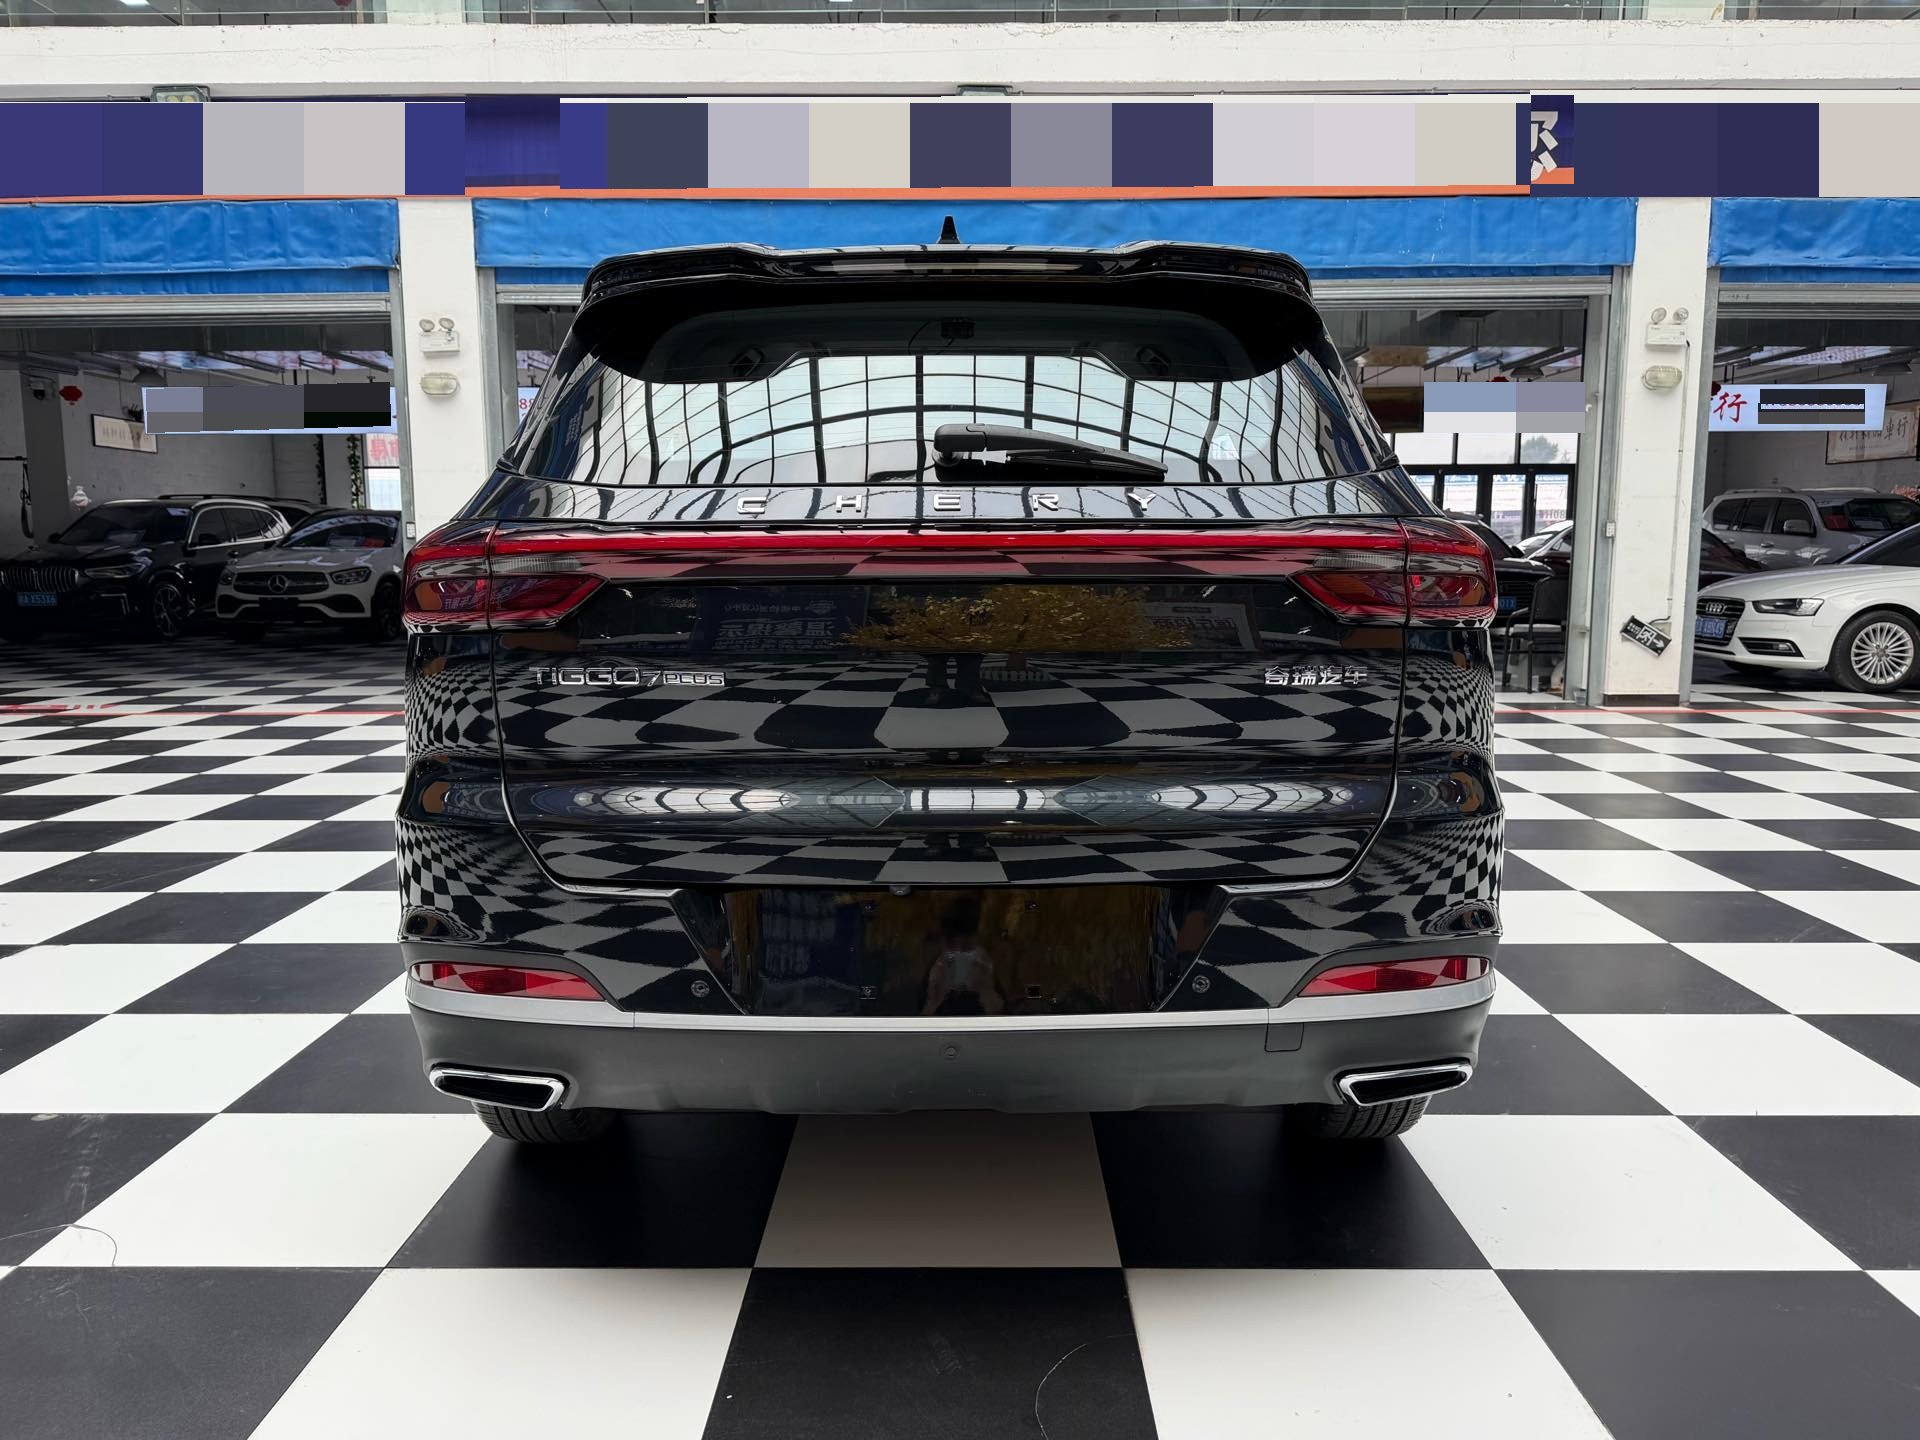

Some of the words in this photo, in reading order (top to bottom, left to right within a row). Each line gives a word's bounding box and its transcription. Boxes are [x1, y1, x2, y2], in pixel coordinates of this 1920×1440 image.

[736, 492, 1157, 515] CHERY
[529, 667, 640, 686] TIGGO
[1264, 665, 1368, 686] 奇瑞汽车
